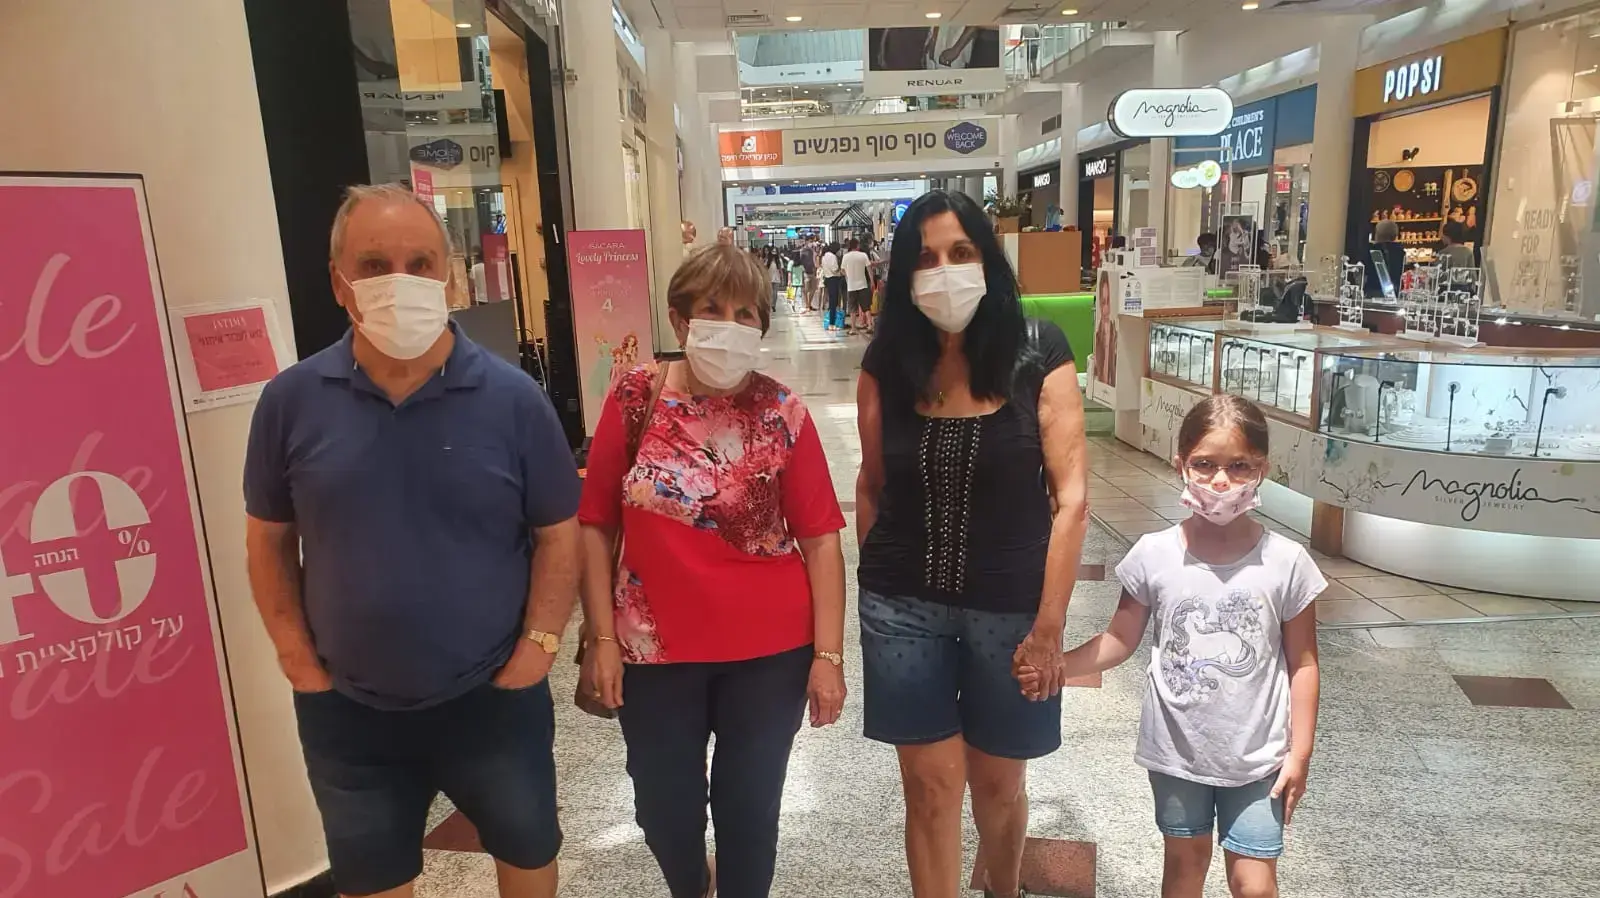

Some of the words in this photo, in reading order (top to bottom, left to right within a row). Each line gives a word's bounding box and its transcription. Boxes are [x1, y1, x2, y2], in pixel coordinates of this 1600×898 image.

[907, 78, 963, 87] RENUAR
[1383, 55, 1443, 103] POPSI
[1133, 95, 1218, 128] Magnolia
[1231, 110, 1264, 128] CHILDREN'S
[793, 136, 860, 155] נפגשים
[866, 134, 898, 157] סוף
[904, 132, 937, 156] סוף
[946, 132, 984, 141] WELCOME
[955, 140, 976, 149] BACK
[1219, 127, 1264, 163] PLACE
[575, 251, 602, 264] Lovely
[603, 251, 639, 263] Princess
[602, 298, 614, 312] 4
[1401, 468, 1579, 522] Magnolia
[1435, 496, 1465, 505] SILVER
[1482, 501, 1525, 511] JEWELRY
[33, 547, 80, 568] הנחה
[151, 614, 184, 639] על
[15, 624, 142, 674] קולקציית
